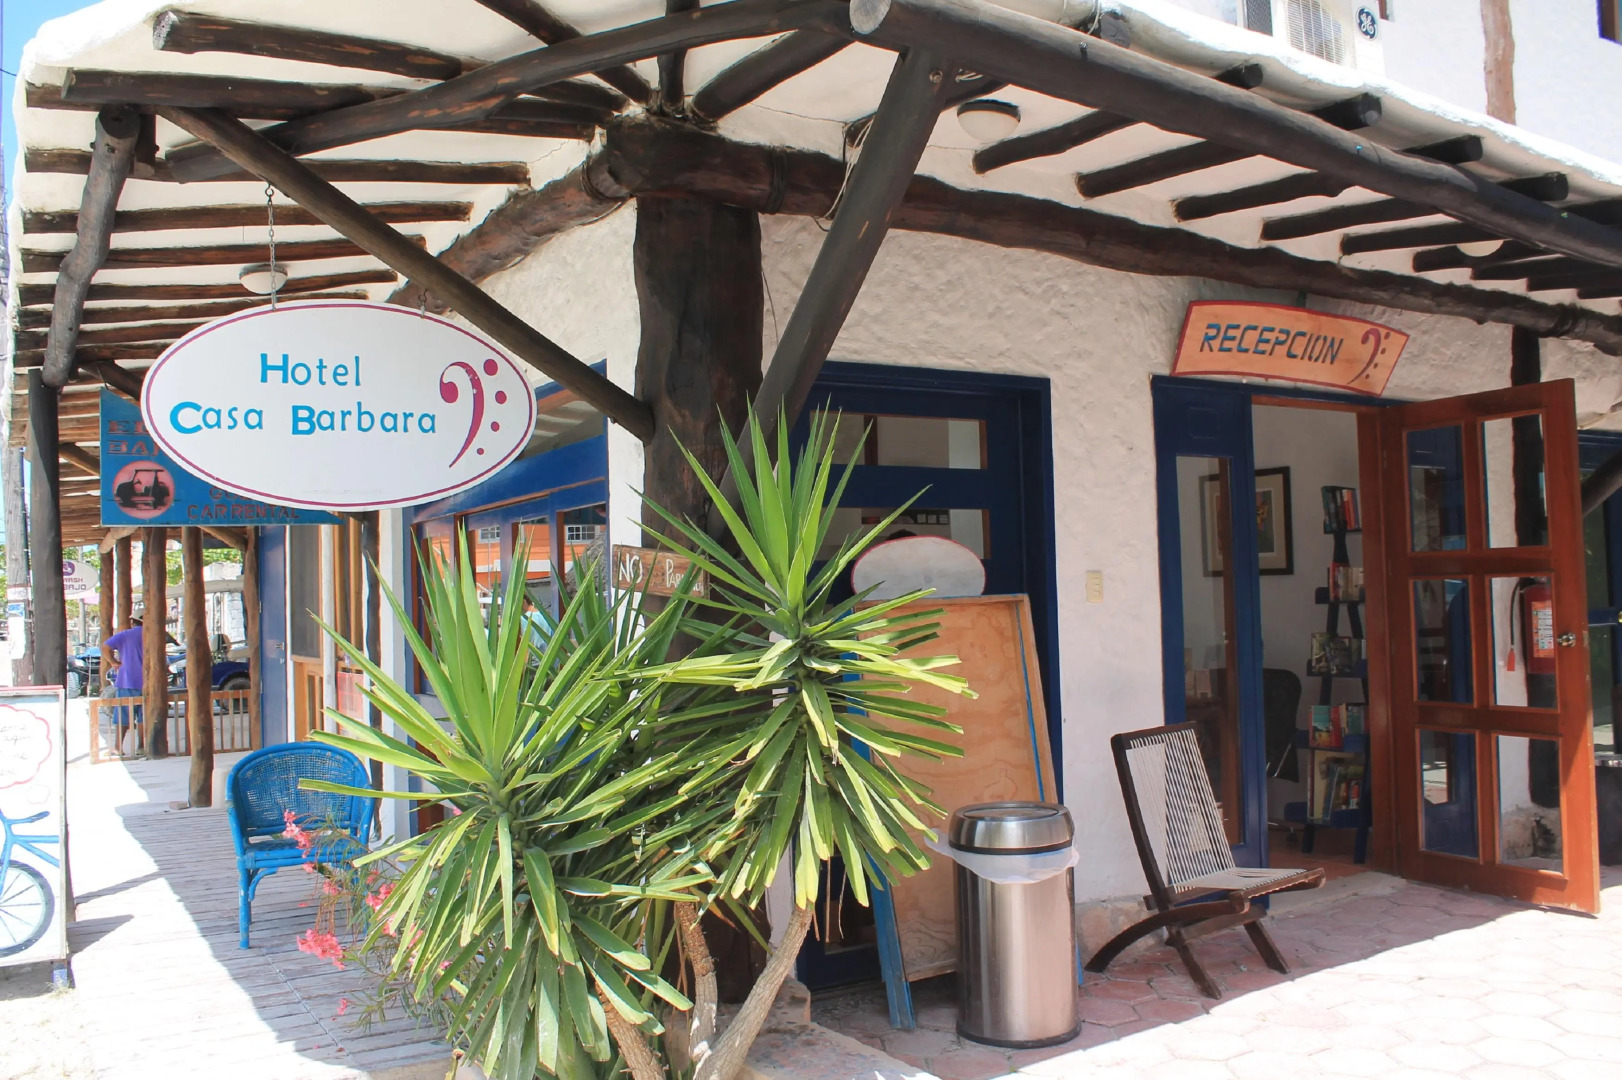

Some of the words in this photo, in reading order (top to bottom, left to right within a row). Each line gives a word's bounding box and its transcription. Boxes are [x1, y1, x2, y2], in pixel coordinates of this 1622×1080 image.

[1200, 323, 1343, 364] RECEPCION
[260, 353, 362, 387] Hotel
[170, 401, 264, 435] Casa
[291, 401, 437, 435] Barbara
[187, 504, 227, 520] CAR
[231, 503, 300, 520] RENTAL
[617, 551, 643, 584] NO
